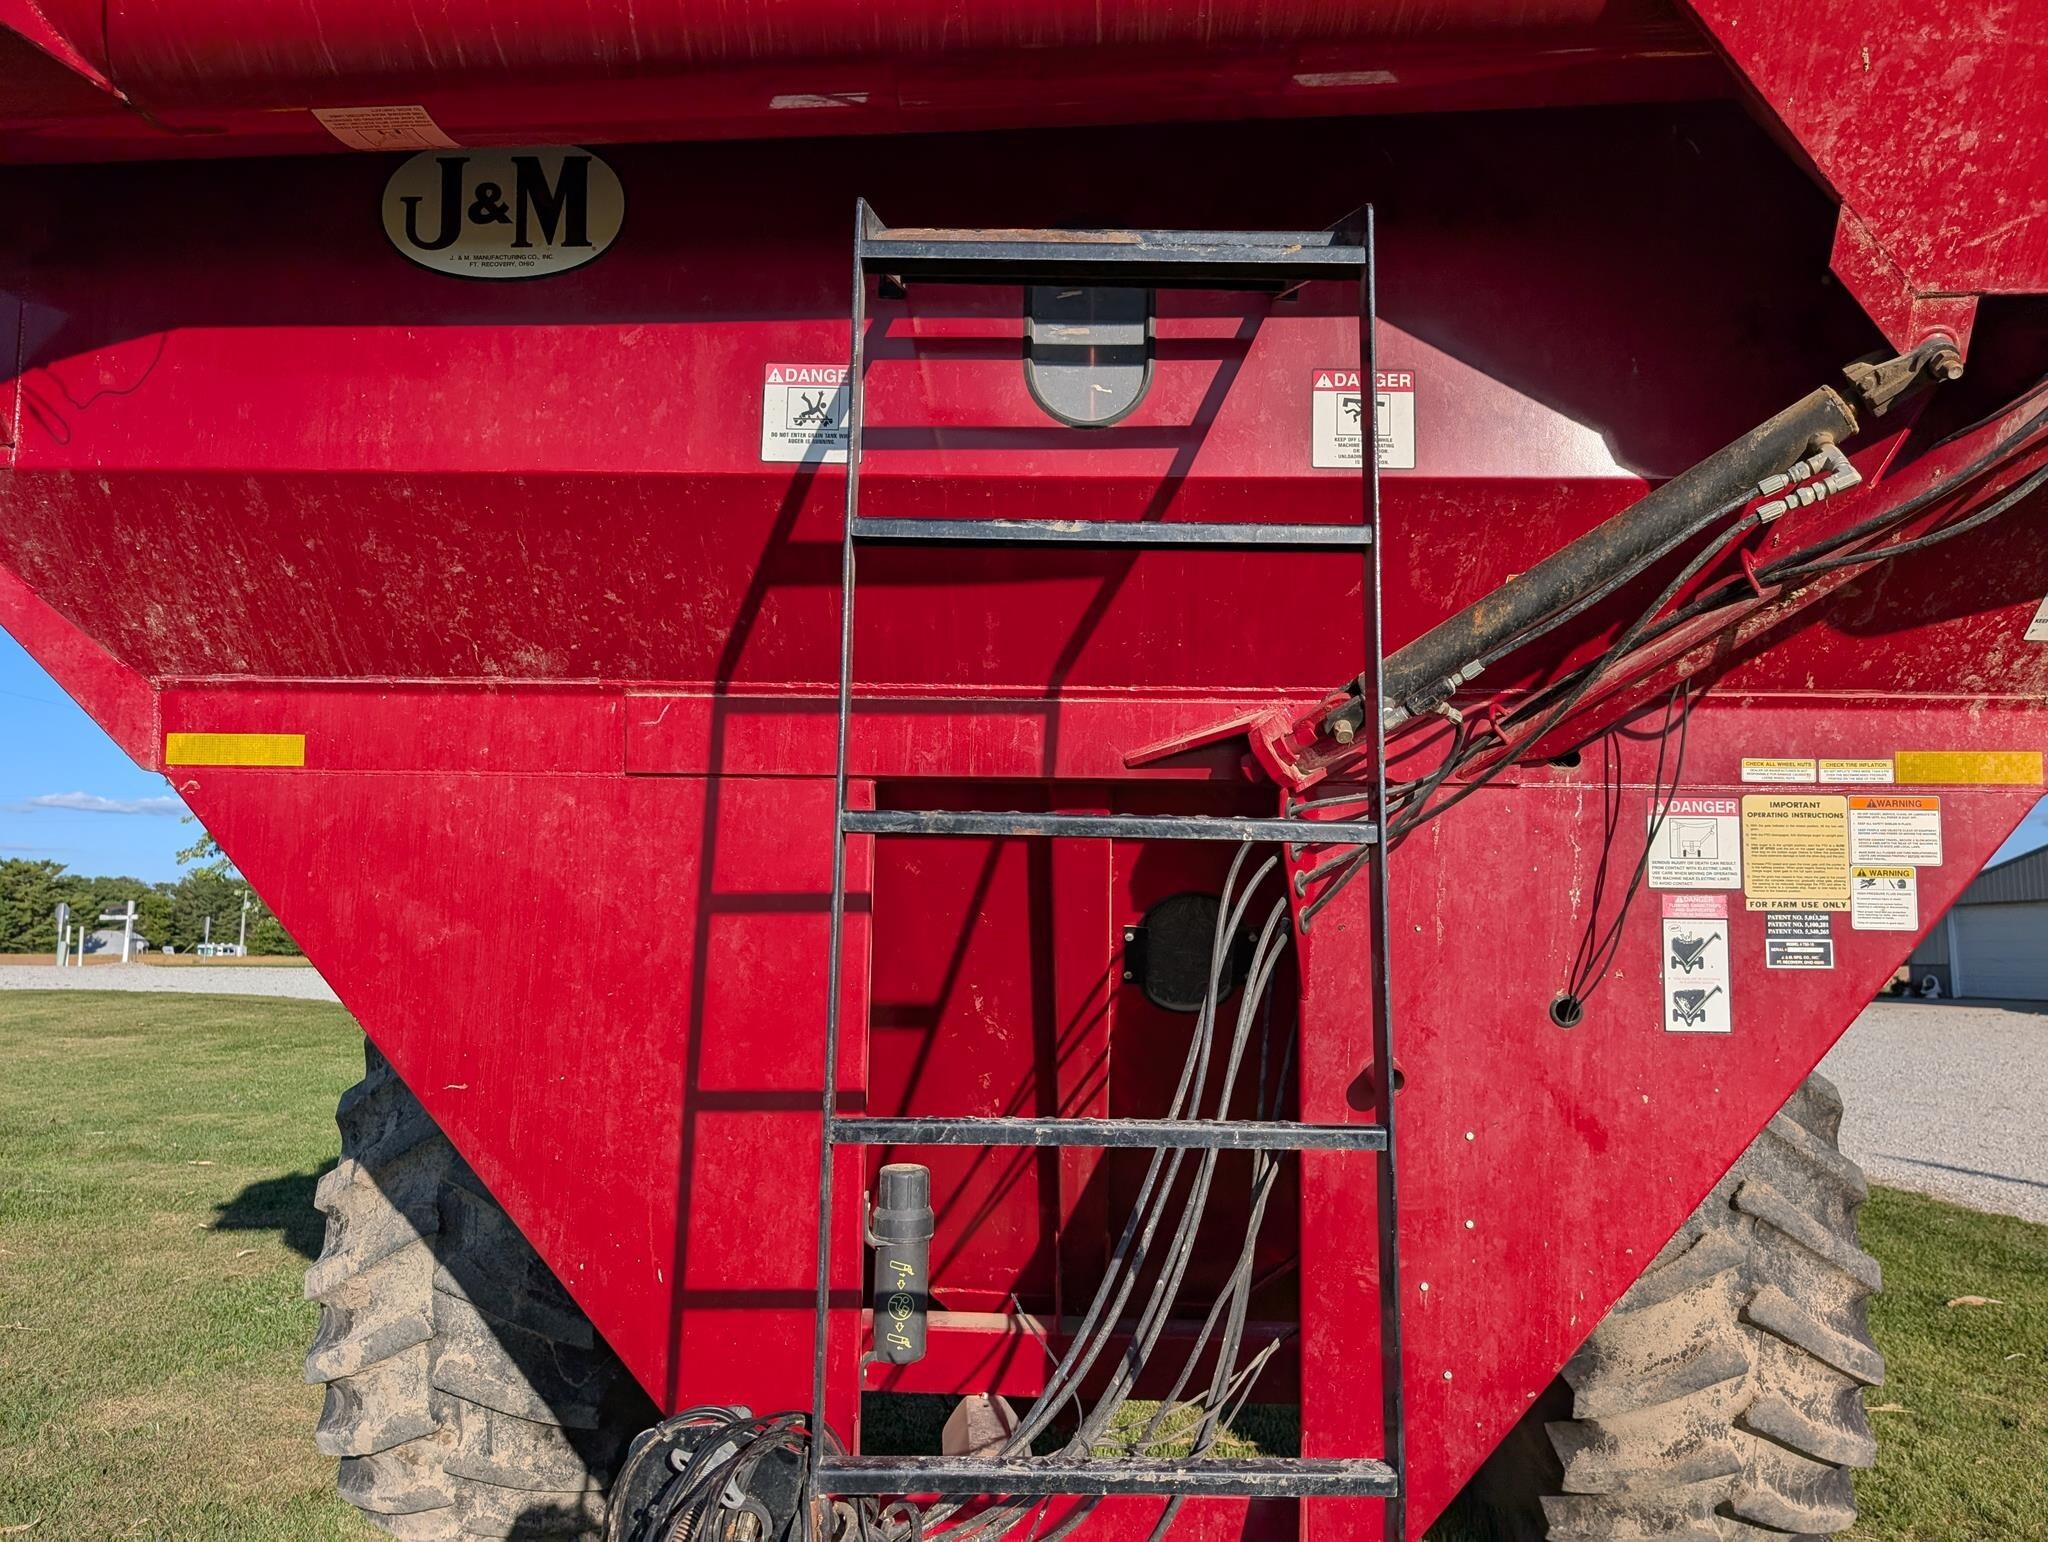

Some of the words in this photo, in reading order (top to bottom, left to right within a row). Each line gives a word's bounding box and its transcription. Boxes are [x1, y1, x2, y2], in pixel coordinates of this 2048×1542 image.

[400, 155, 592, 250] J&M
[785, 368, 849, 383] DANGE
[1334, 373, 1411, 387] DAGER
[1670, 801, 1736, 813] DANGER
[1876, 800, 1922, 808] WARNING
